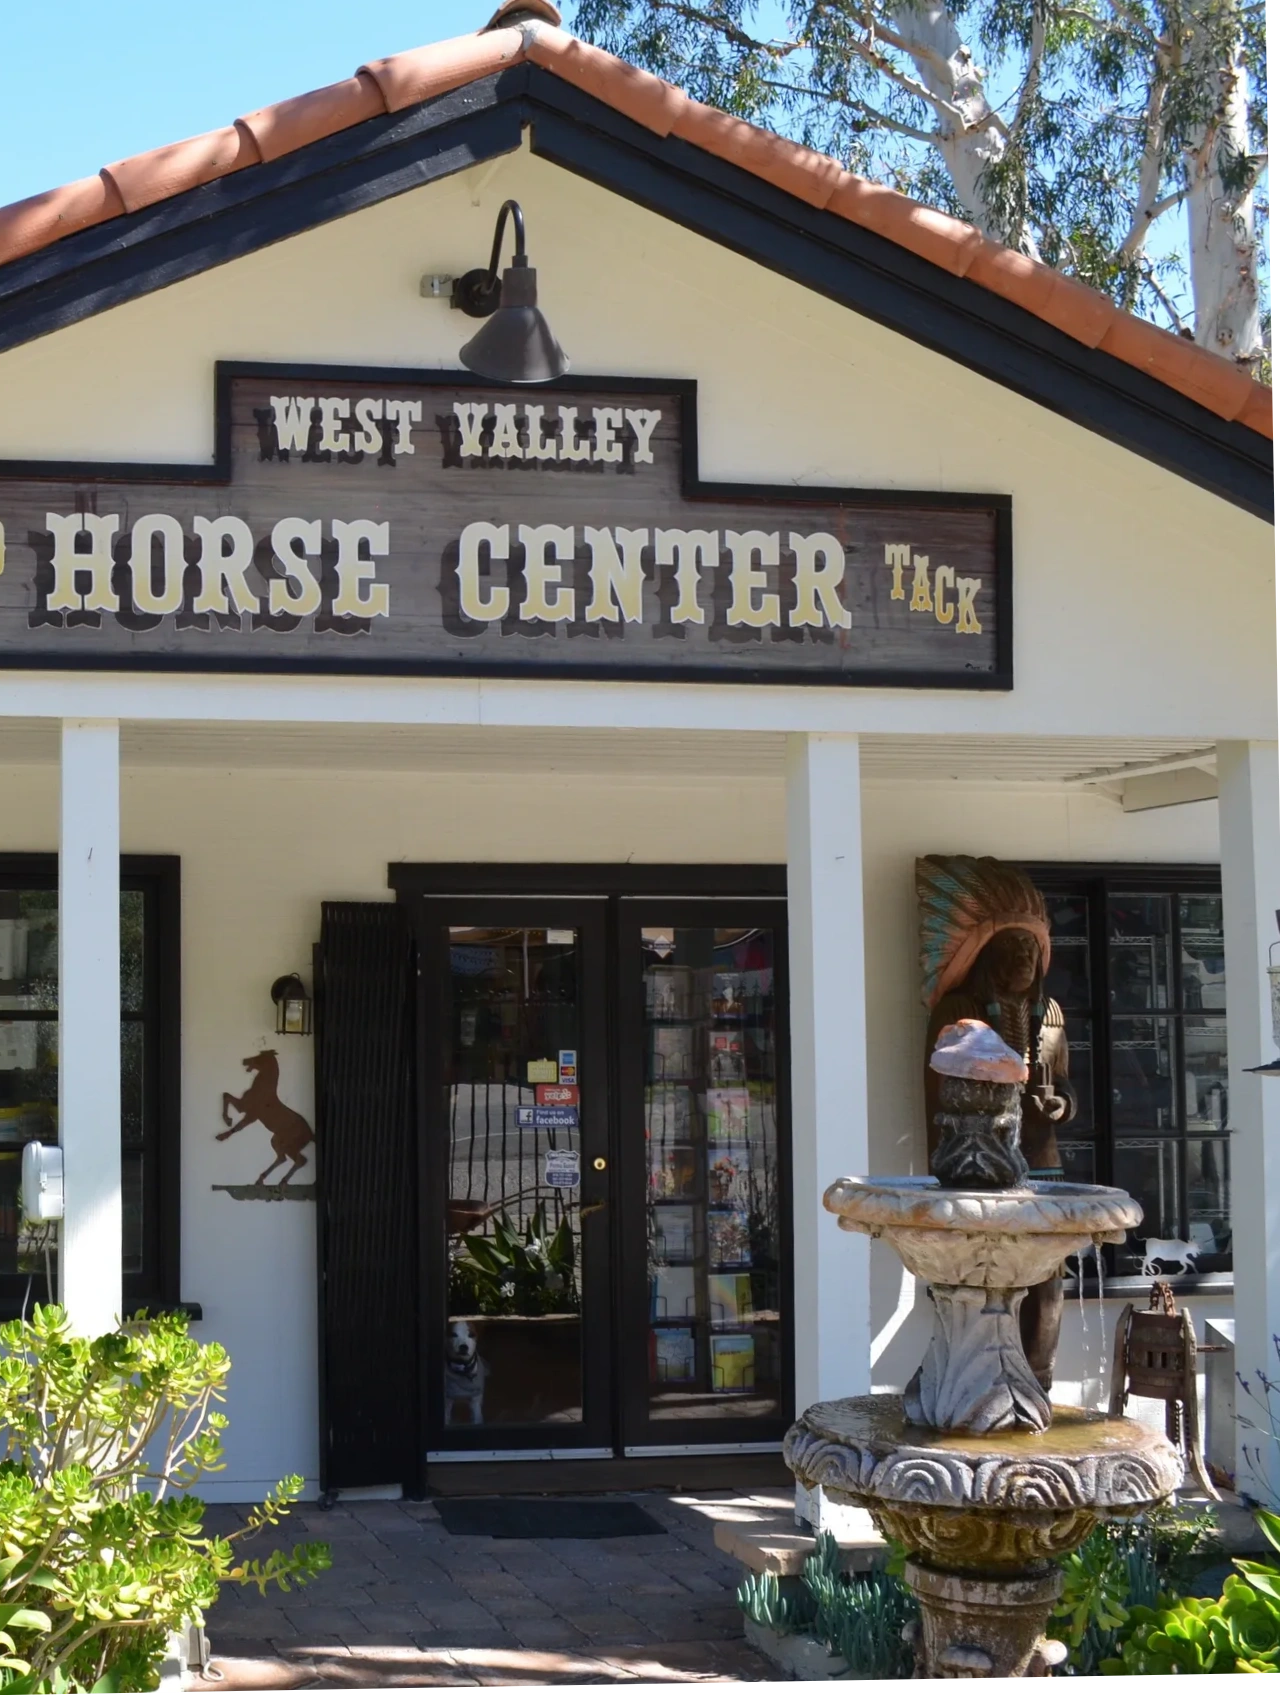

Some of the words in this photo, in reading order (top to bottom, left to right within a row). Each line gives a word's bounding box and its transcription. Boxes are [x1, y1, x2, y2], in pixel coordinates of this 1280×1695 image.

[270, 396, 422, 455] WEST
[453, 402, 662, 464] VALLEY
[45, 512, 390, 618] HORSE
[454, 521, 852, 630] CENTER
[884, 544, 983, 635] TACK
[536, 1115, 575, 1124] facebook
